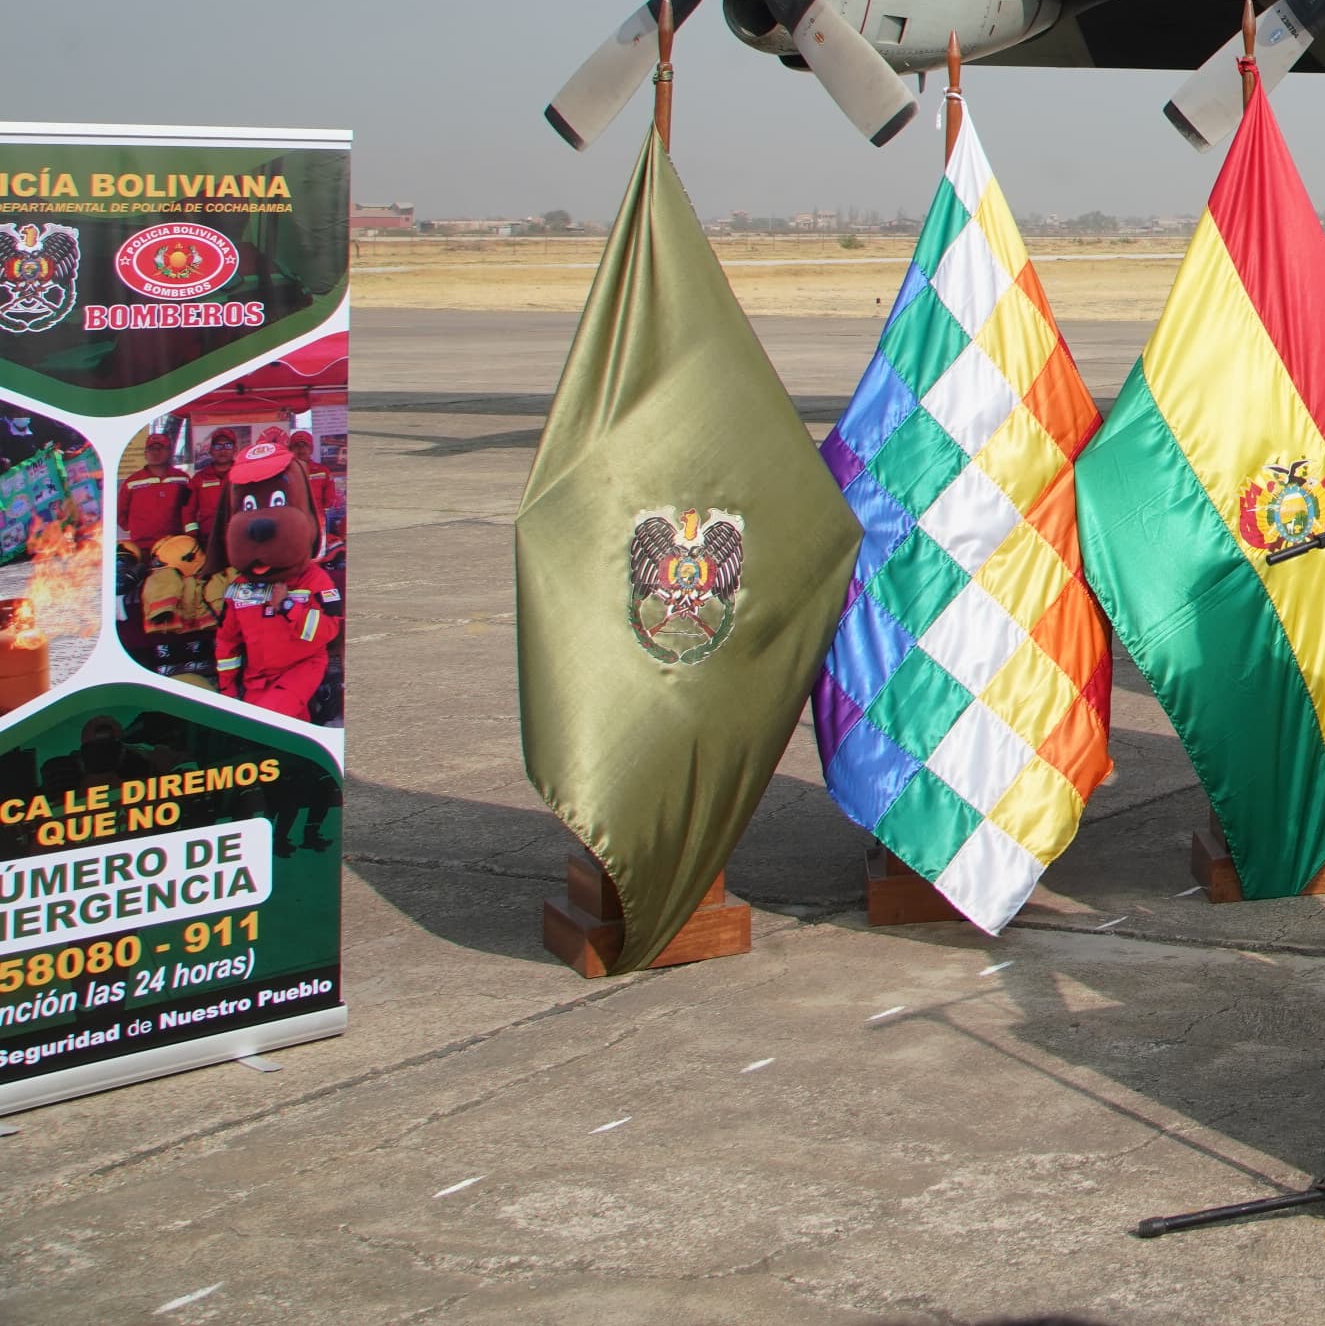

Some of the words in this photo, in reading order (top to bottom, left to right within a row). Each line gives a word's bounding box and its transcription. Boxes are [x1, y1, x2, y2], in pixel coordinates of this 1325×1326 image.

[90, 173, 292, 198] BOLIVIANA
[0, 202, 108, 213] EPARTAMENTAL
[110, 202, 129, 213] DE
[131, 200, 182, 213] POLICÍA
[185, 202, 203, 213] DE
[205, 202, 293, 213] COCHABAMBA
[127, 227, 170, 254] POLICIA
[173, 226, 231, 254] BOLIVIANA
[143, 282, 212, 297] BOMBEROS
[85, 301, 265, 330] BOMBEROS
[64, 784, 110, 814] LE
[120, 759, 280, 805] DIREMOS
[36, 811, 117, 846] QUE
[128, 802, 181, 832] NO
[186, 832, 242, 870] DE
[0, 866, 257, 941] ERGENCIA
[183, 910, 259, 954] 911
[85, 981, 126, 1008] las
[133, 965, 166, 997] 24
[172, 947, 255, 989] horas)
[126, 1018, 152, 1037] de
[159, 997, 251, 1030] Nuestro
[258, 979, 332, 1007] Pueblo
